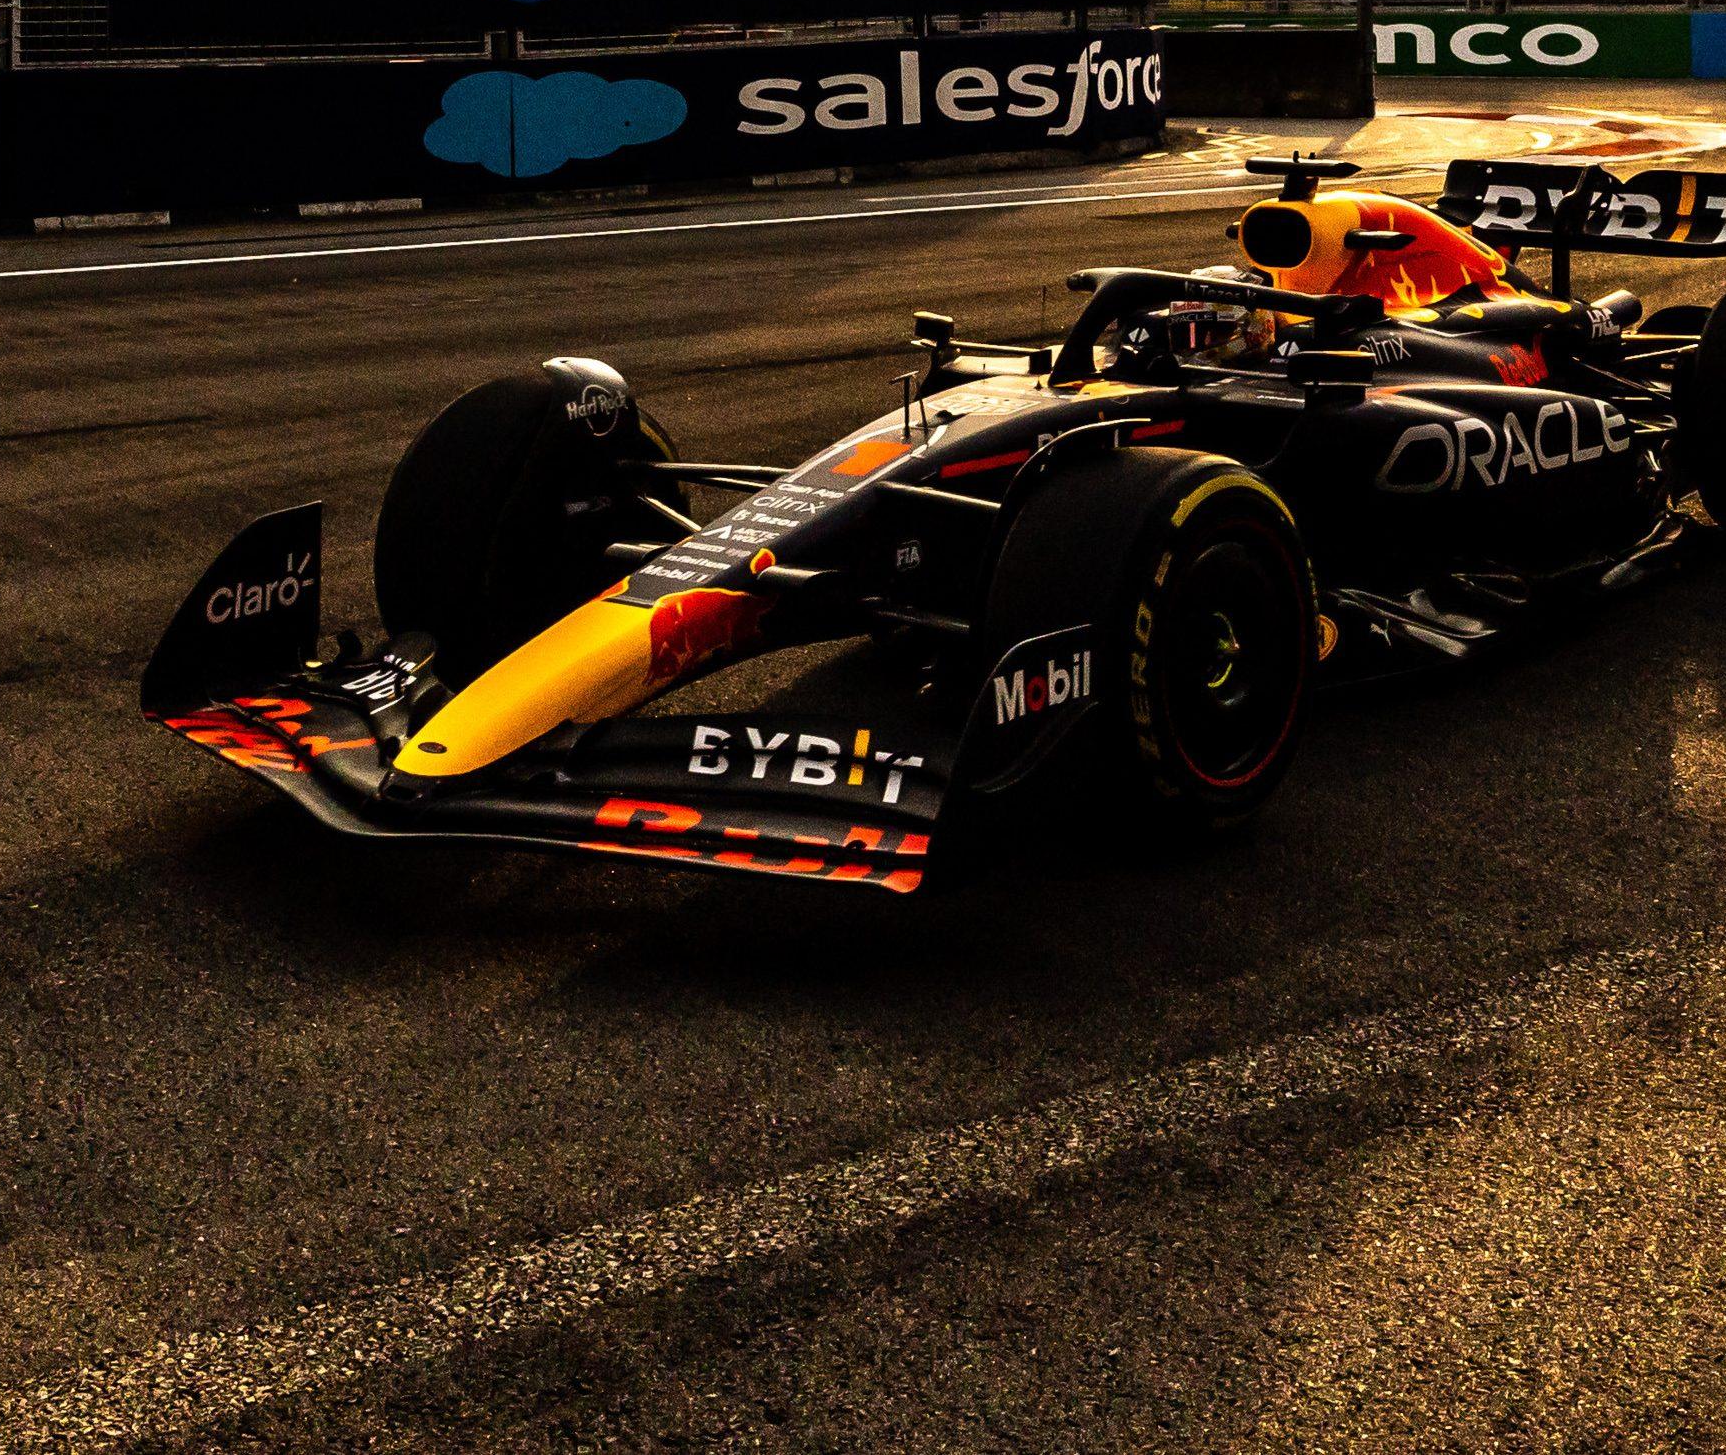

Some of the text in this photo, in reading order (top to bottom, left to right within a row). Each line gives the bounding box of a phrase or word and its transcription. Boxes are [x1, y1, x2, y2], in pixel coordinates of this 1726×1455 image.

[736, 39, 1162, 137] salesforce
[1376, 400, 1631, 494] ORACLE
[753, 496, 826, 513] citrix
[206, 576, 301, 623] Claro
[993, 650, 1092, 725] Mobil
[688, 725, 924, 804] BYBIT
